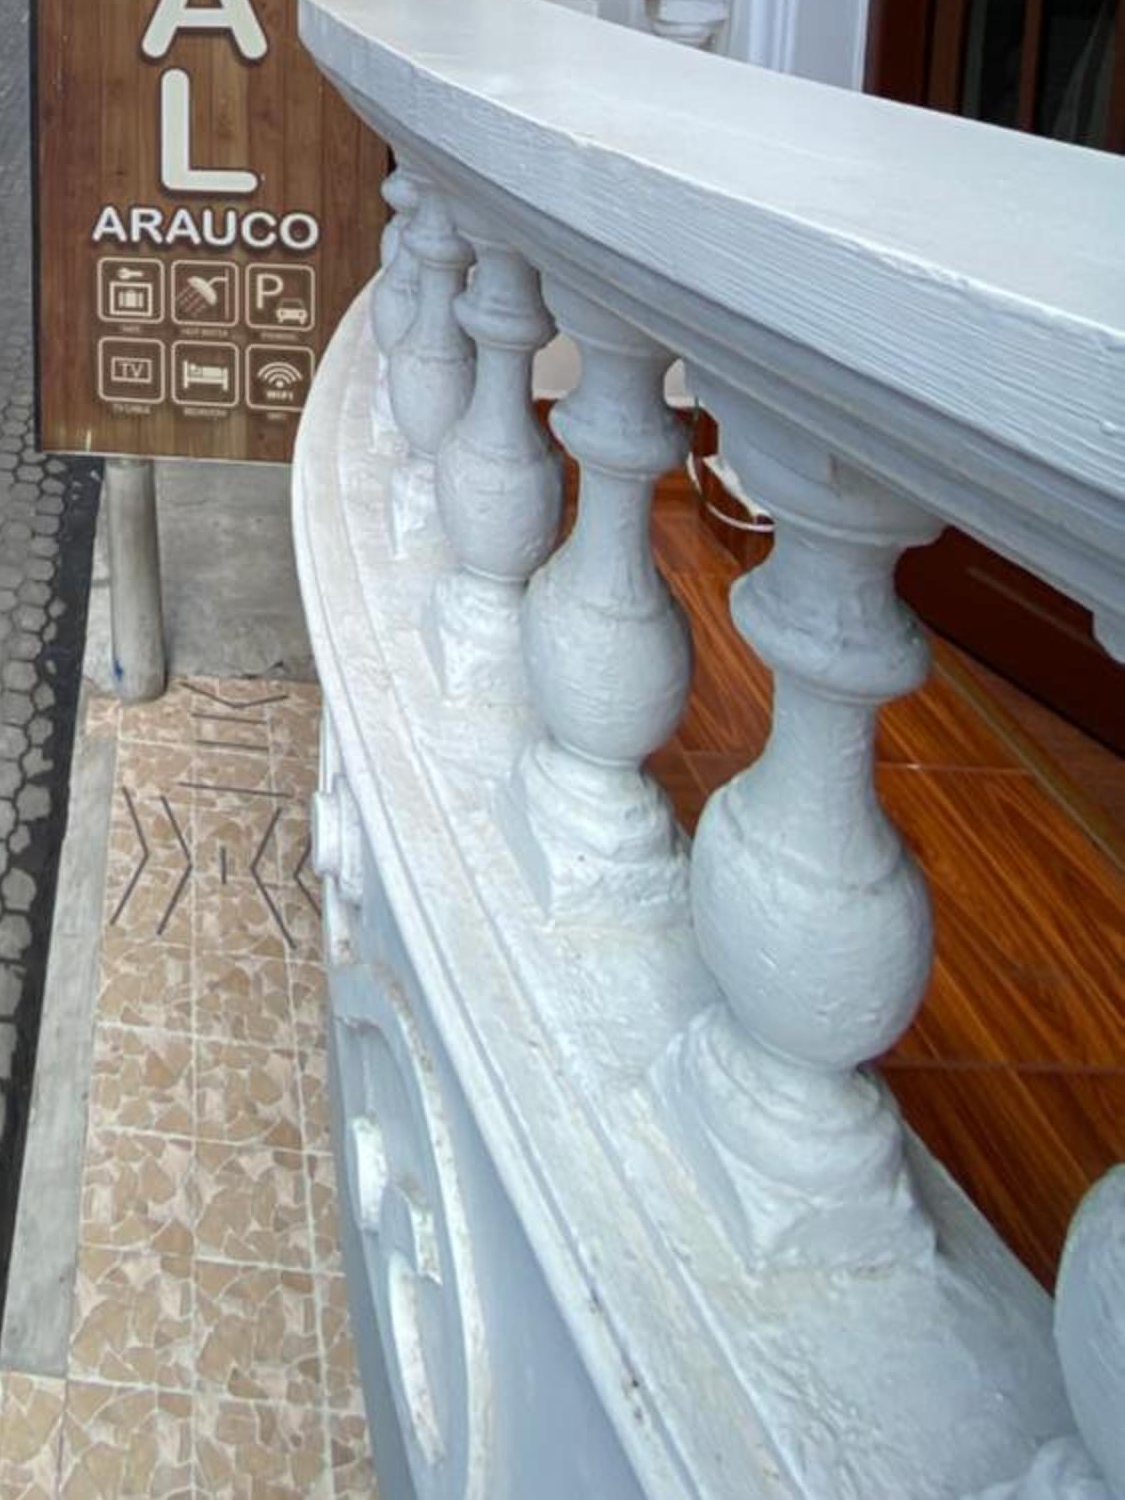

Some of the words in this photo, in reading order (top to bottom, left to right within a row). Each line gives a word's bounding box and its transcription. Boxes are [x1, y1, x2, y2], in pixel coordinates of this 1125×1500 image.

[91, 206, 319, 250] ARAUCO
[255, 272, 283, 310] P
[120, 363, 143, 379] TV
